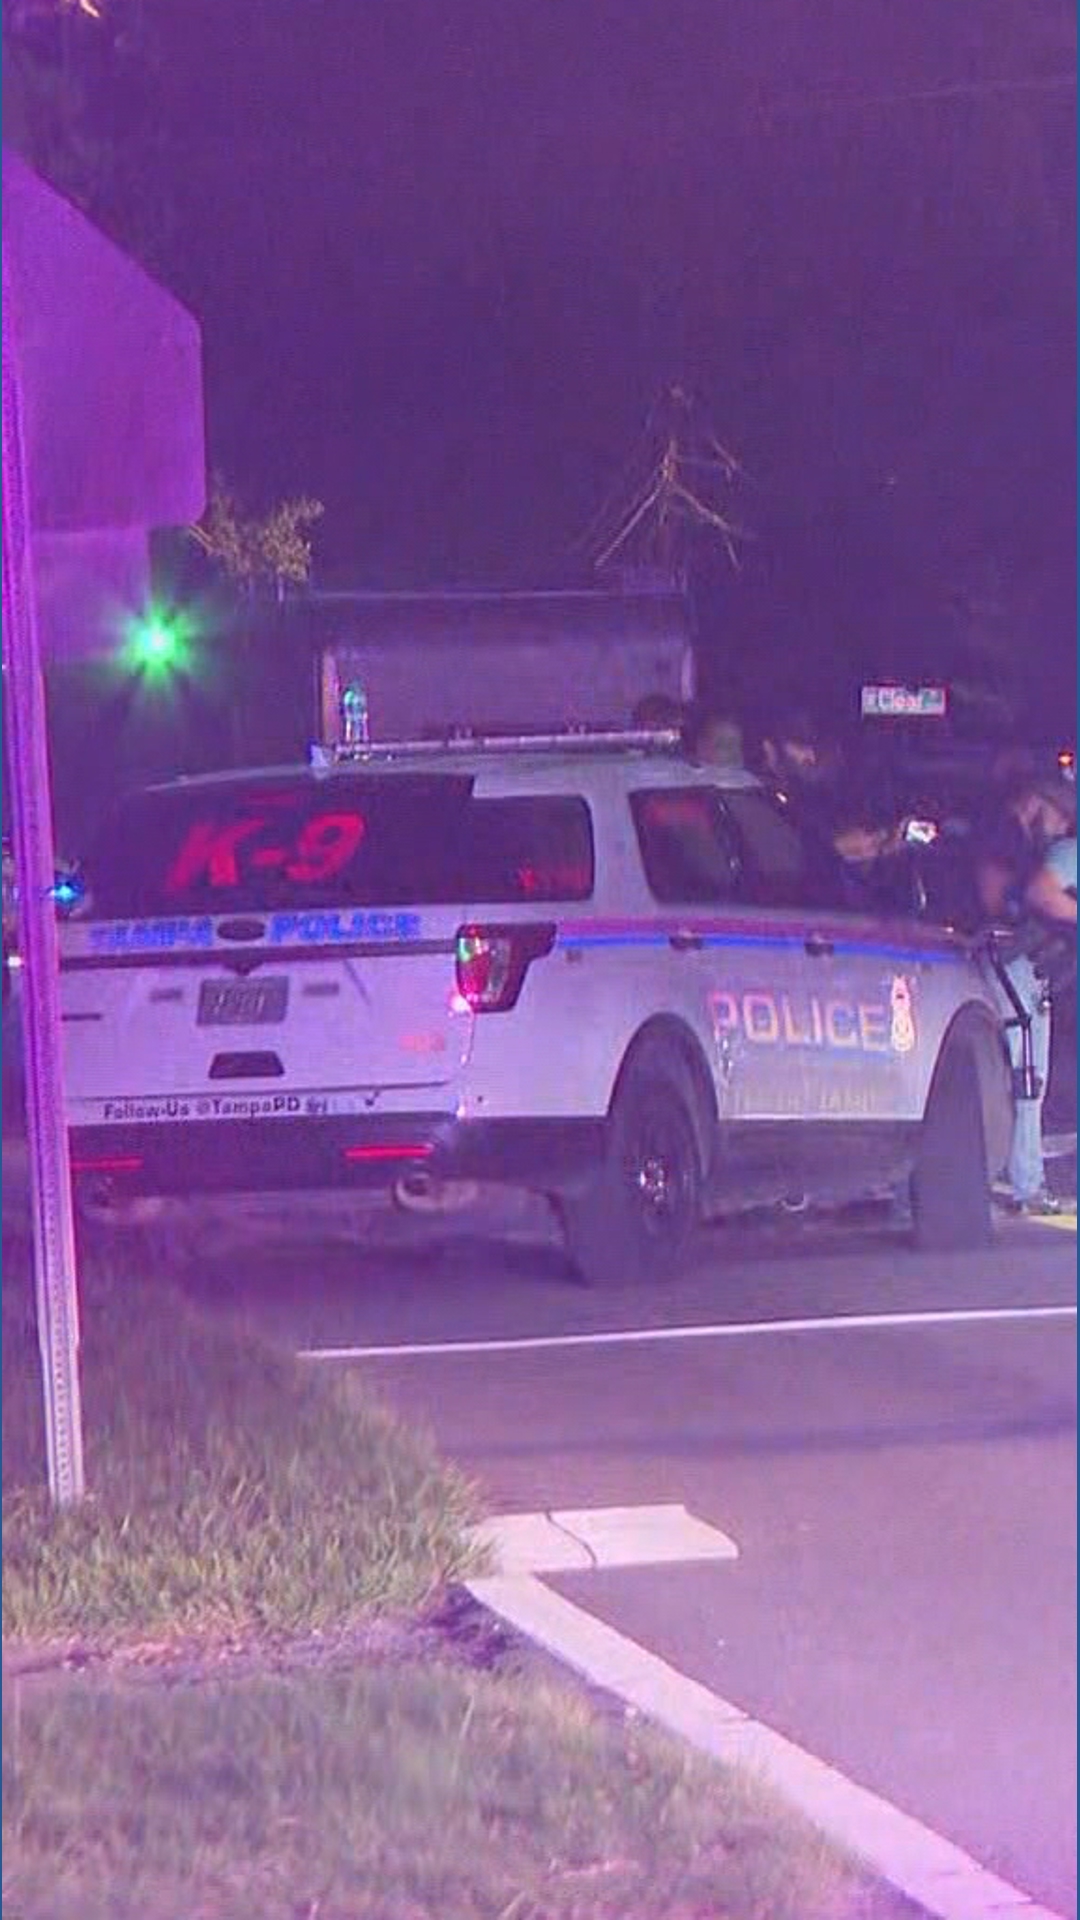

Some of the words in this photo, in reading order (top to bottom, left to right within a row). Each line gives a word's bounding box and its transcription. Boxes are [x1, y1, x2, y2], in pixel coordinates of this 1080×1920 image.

[166, 811, 366, 891] K-9
[269, 911, 421, 943] POLICE
[710, 991, 886, 1049] POLICE
